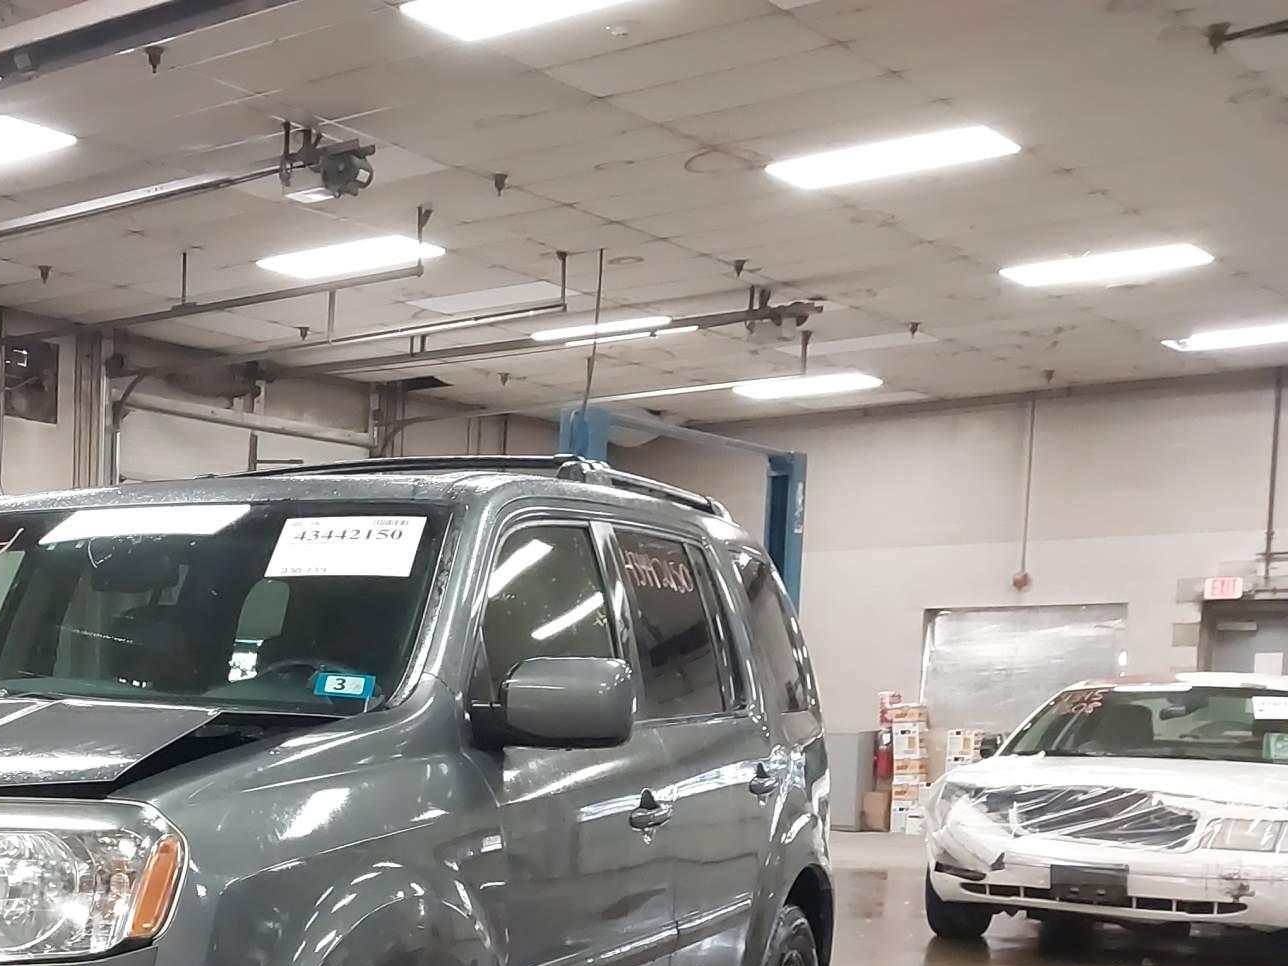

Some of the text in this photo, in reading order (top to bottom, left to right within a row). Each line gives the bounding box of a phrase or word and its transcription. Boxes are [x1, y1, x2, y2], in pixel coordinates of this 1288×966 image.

[294, 528, 404, 541] 43442150
[1211, 579, 1237, 597] EXIT
[333, 677, 347, 691] 3
